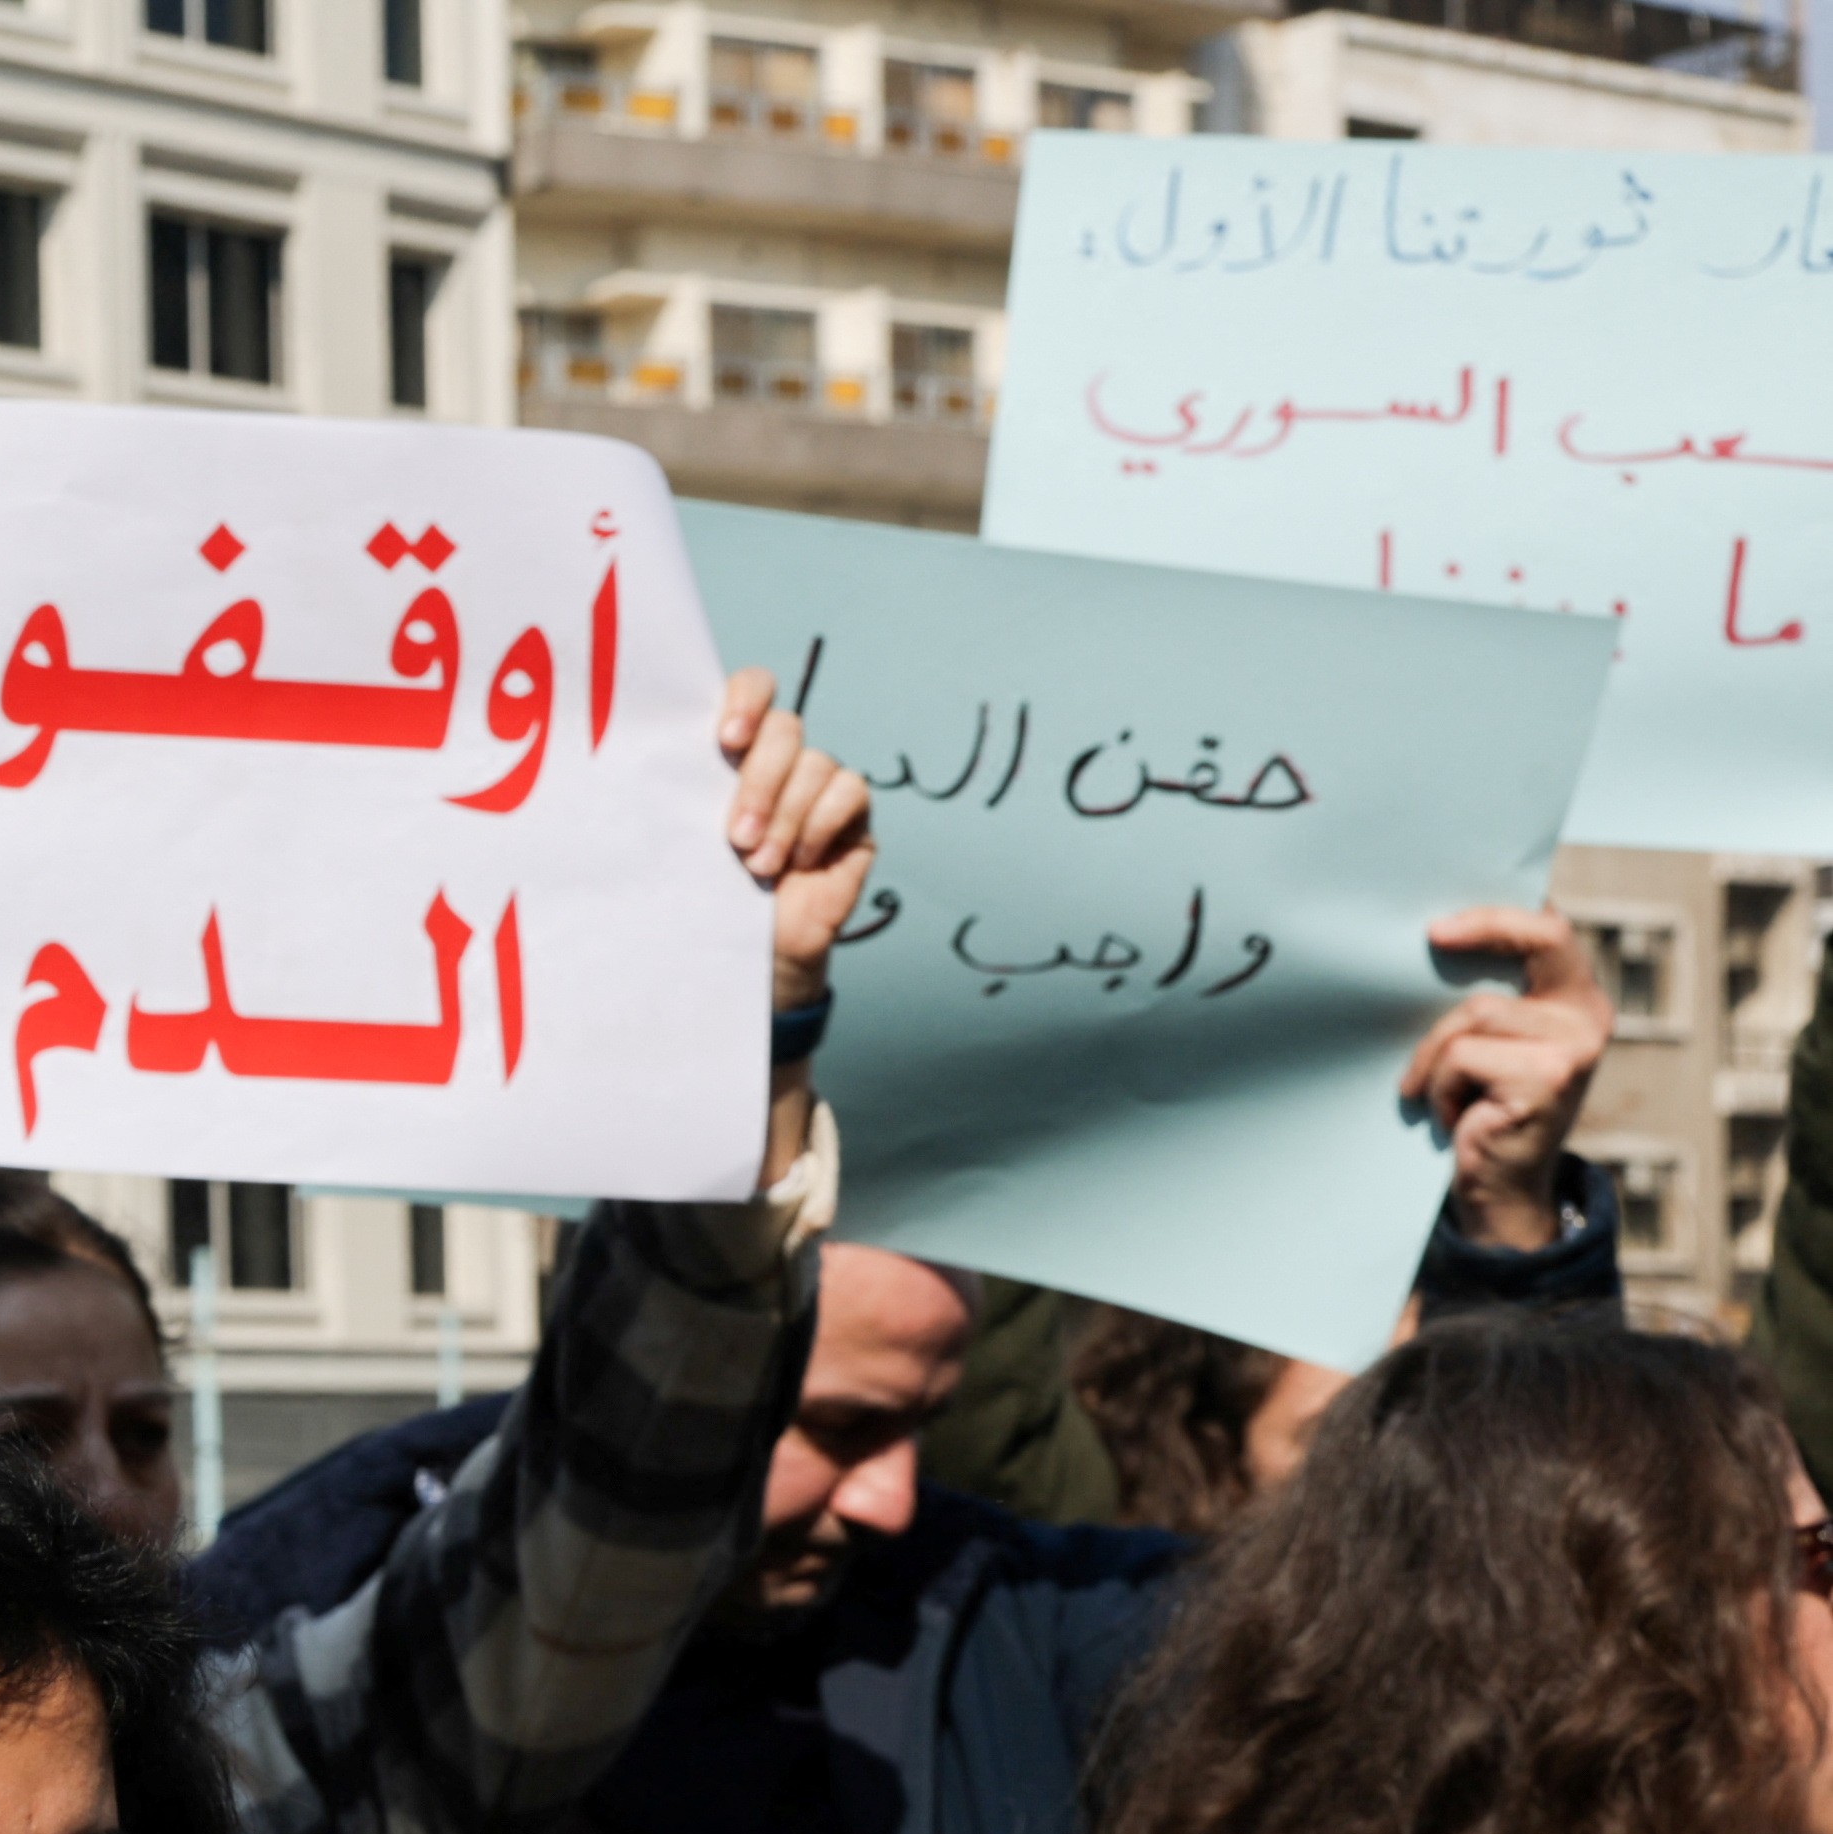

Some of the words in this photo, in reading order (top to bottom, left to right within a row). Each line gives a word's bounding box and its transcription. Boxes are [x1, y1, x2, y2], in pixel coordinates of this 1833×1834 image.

[1385, 150, 1655, 282] ثورتنا
[1086, 364, 1511, 475] السوري
[1065, 728, 1309, 818] حقن
[950, 886, 1275, 997] واجب
[13, 882, 526, 1142] الدم
